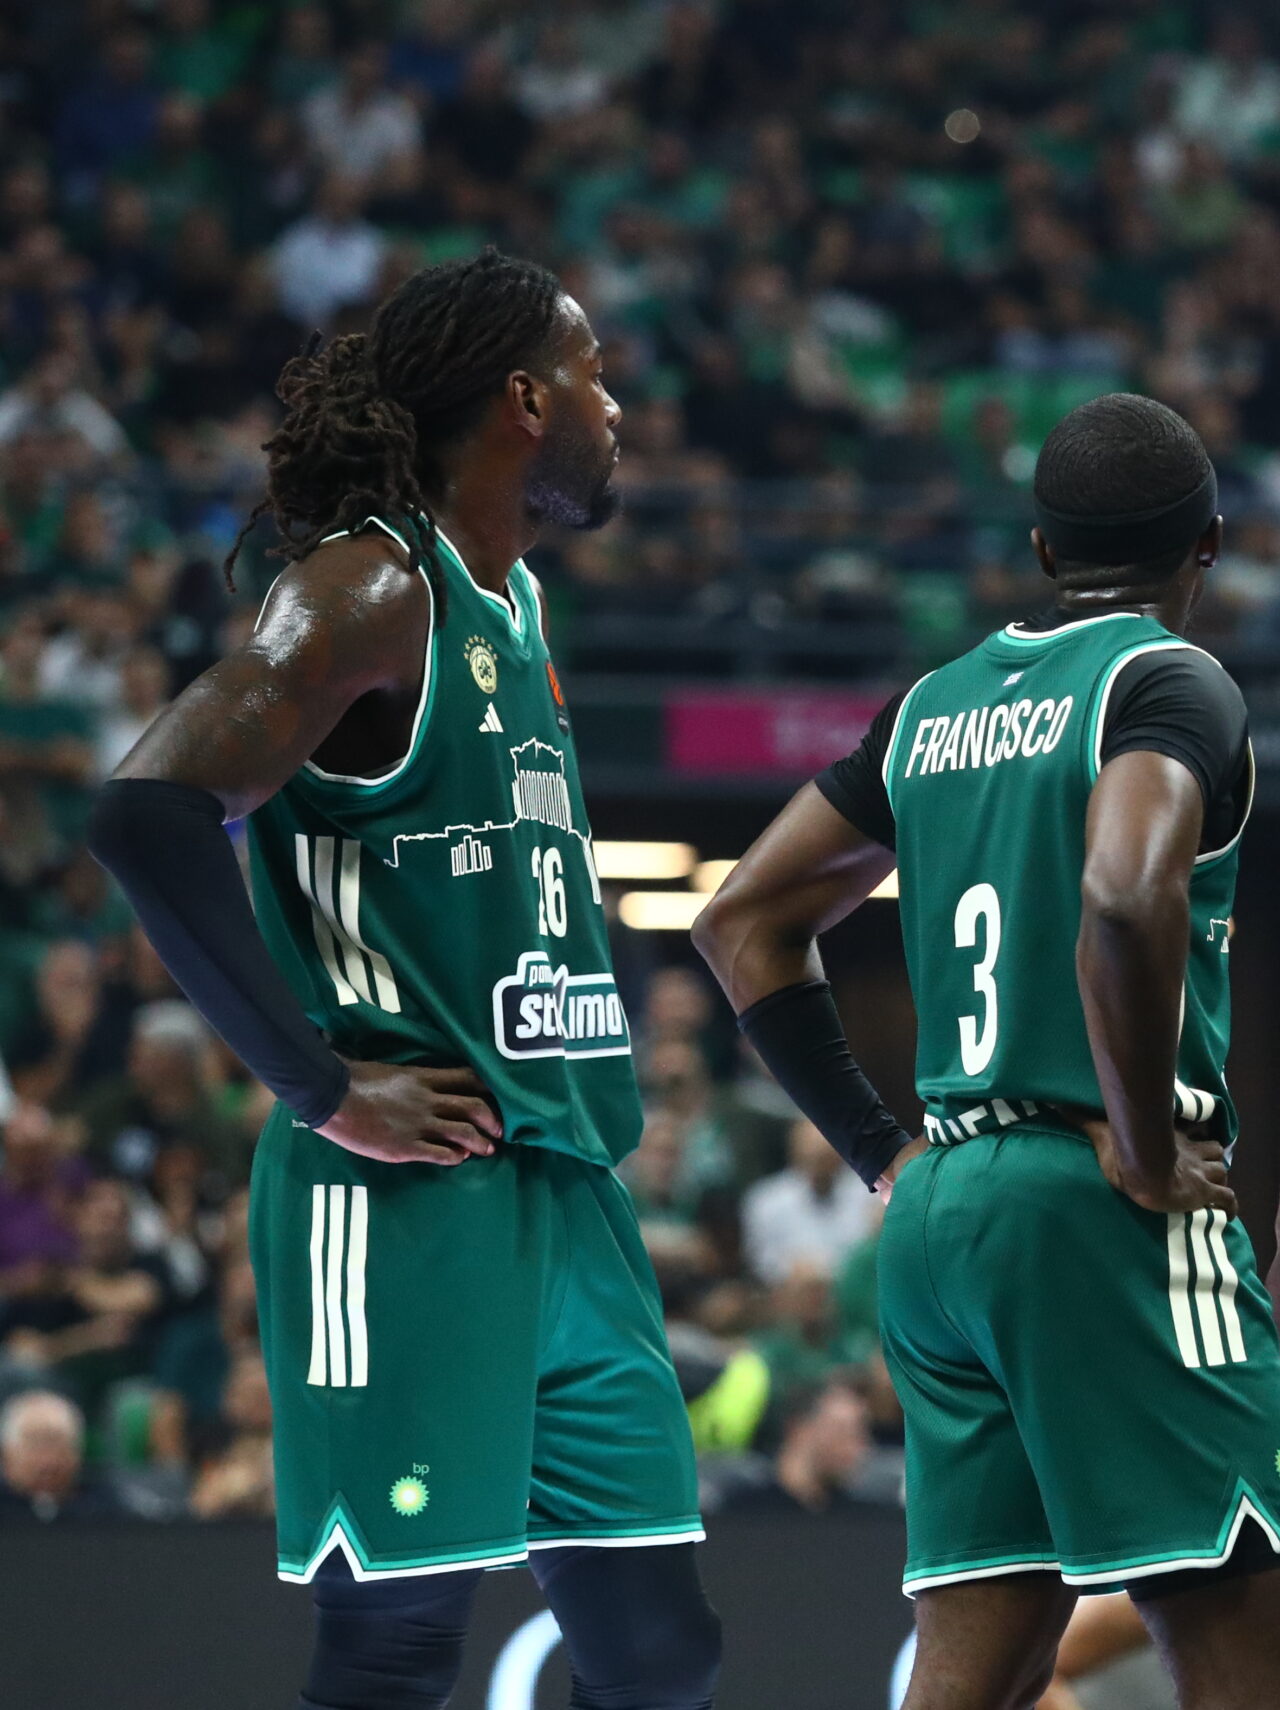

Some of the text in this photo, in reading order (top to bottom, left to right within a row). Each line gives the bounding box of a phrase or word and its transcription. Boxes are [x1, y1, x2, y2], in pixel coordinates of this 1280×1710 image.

[904, 695, 1074, 778] FRANCISCO
[953, 882, 1001, 1076] 3
[412, 1462, 430, 1476] bp
